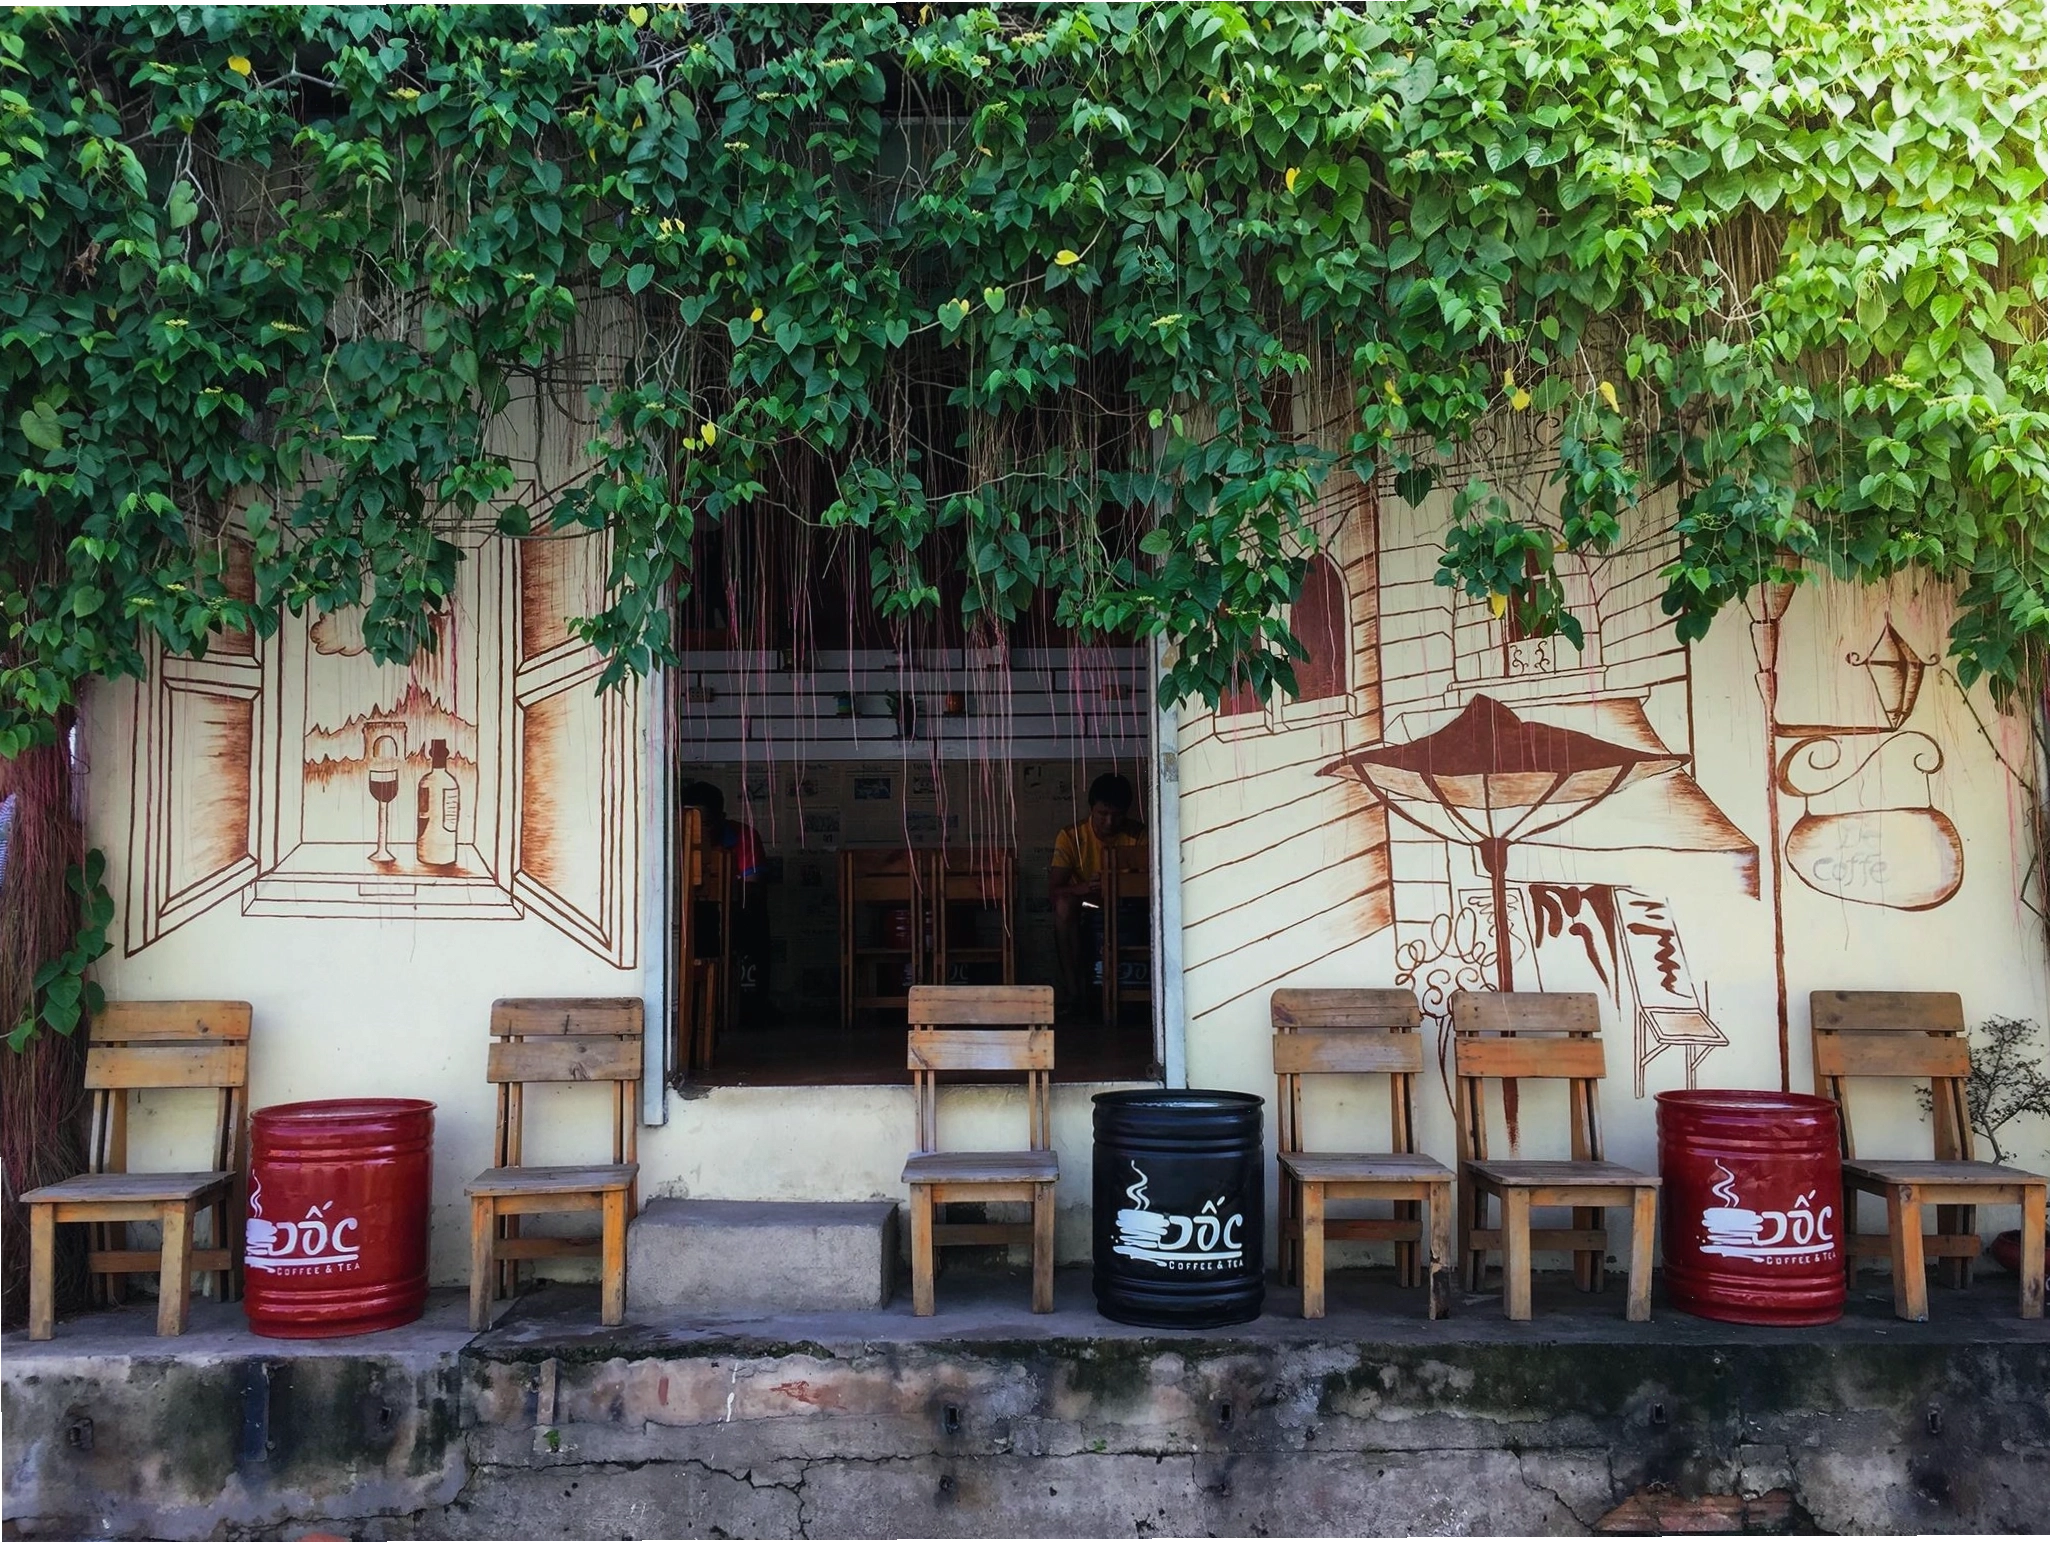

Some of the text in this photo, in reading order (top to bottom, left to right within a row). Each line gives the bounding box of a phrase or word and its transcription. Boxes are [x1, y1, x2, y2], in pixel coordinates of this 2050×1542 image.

[1168, 1259, 1244, 1270] COFFEE & TEA
[1766, 1255, 1811, 1265] COFFEE
[276, 1262, 361, 1276] COFFEE & TEA
